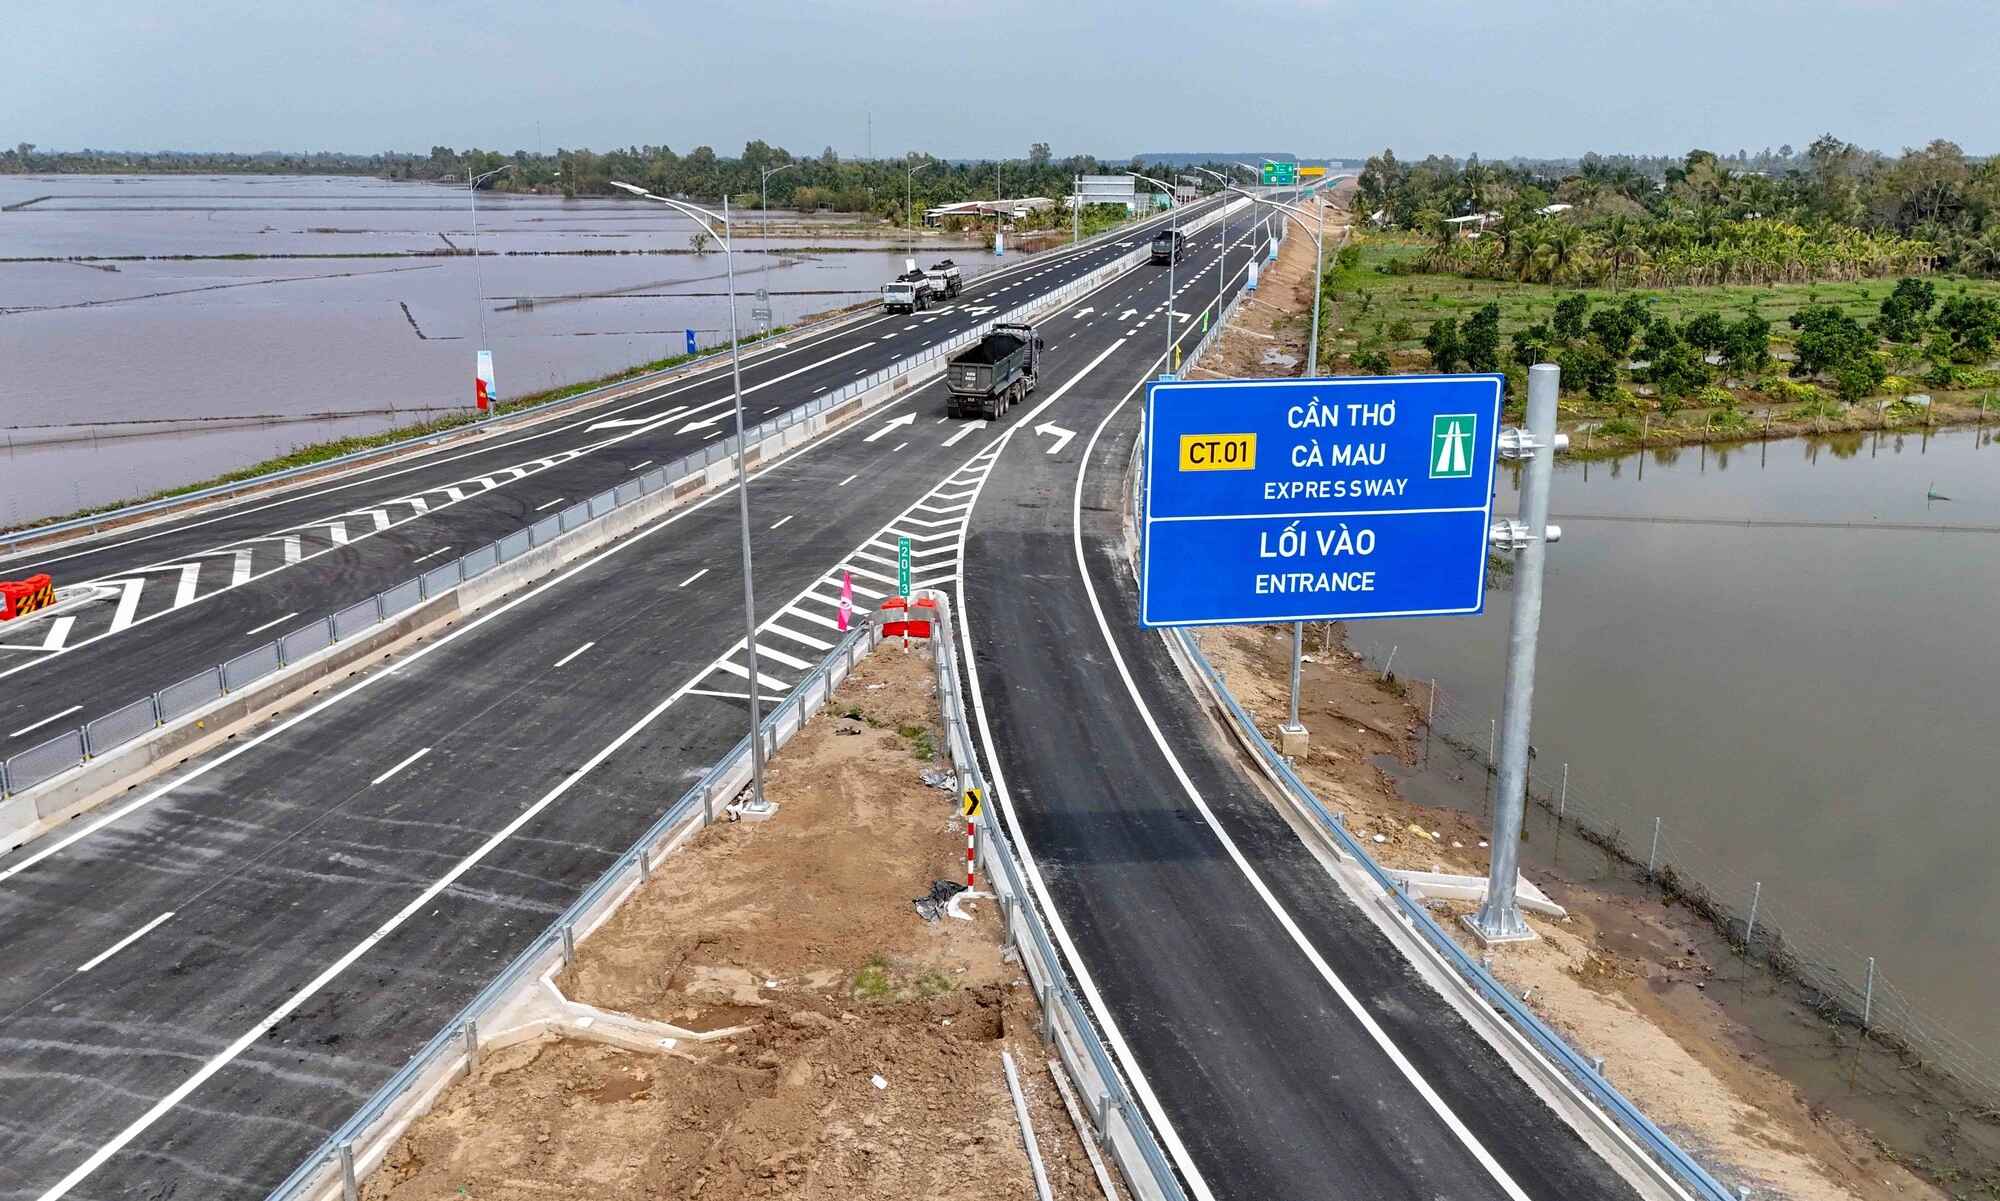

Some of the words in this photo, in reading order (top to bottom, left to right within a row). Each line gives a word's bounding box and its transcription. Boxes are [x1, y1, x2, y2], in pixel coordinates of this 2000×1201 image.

[1288, 397, 1339, 428] CẦN
[1347, 400, 1396, 427] THƠ
[1189, 441, 1248, 464] CT.01
[1291, 439, 1324, 468] CÀ
[1332, 444, 1386, 467] MAU
[1264, 478, 1409, 500] EXPRESSWAY
[1260, 520, 1308, 558] LỐI
[1316, 524, 1376, 556] VÀO
[1255, 572, 1376, 594] ENTRANCE
